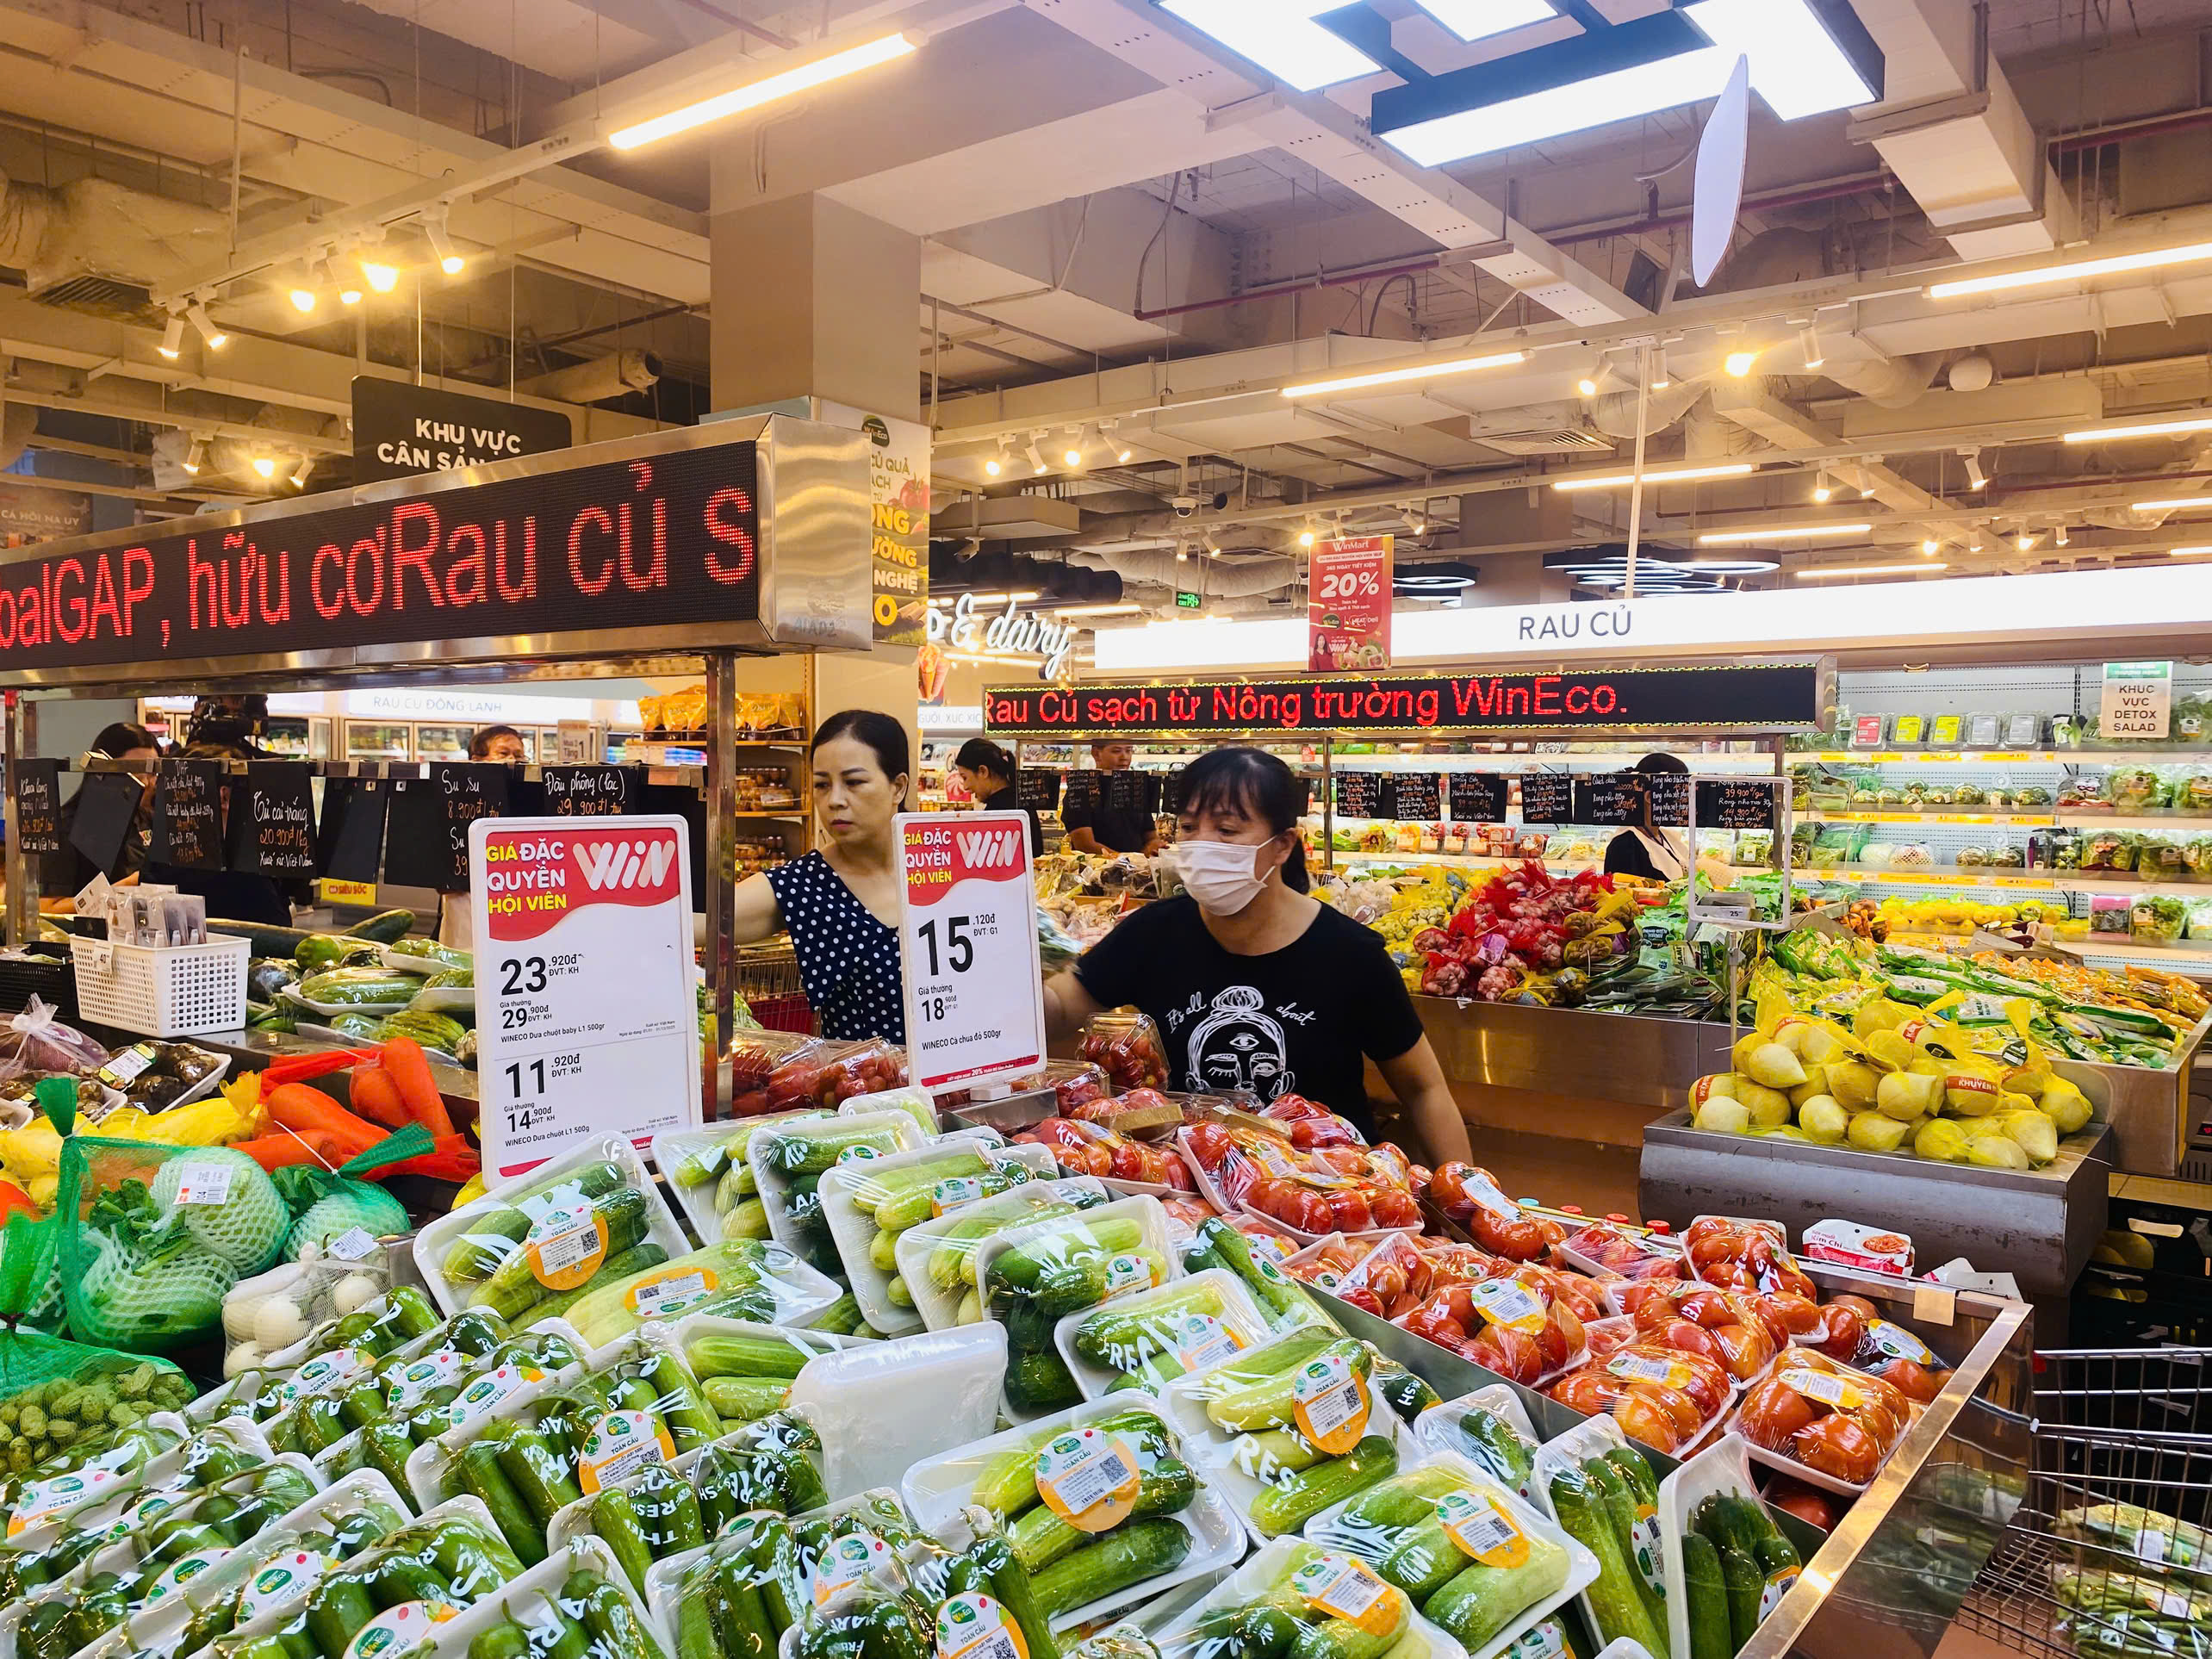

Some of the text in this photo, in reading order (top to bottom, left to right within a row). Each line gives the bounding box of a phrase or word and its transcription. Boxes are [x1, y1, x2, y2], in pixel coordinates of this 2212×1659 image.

[415, 417, 522, 455] KHU VỰC
[376, 442, 431, 469] CÂN
[885, 457, 910, 475] QUẢ
[189, 531, 290, 630] hữu
[569, 458, 668, 596] củ
[704, 485, 754, 586] s
[1333, 541, 1370, 552] WinMart
[873, 569, 918, 593] NGHỆ
[1320, 571, 1380, 598] 20%
[1519, 604, 1632, 641] RAU CỦ
[951, 593, 975, 647] &
[986, 600, 1071, 680] dairy
[374, 696, 401, 709] RAU
[1039, 689, 1078, 723] Củ
[1087, 689, 1157, 728] sạch
[1168, 688, 1202, 722] từ
[1213, 686, 1302, 728] Nông
[1311, 682, 1438, 727] trường
[1451, 676, 1627, 717] WinEco.
[2122, 698, 2149, 708] VỰC
[2113, 723, 2156, 731] SALAD
[579, 741, 584, 758] 1
[442, 769, 459, 794] Su
[570, 771, 595, 798] phộng
[1718, 798, 1737, 807] Rong
[904, 828, 952, 848] GIÁ ĐẶC
[486, 837, 565, 865] GIÁ ĐẶC
[905, 848, 951, 868] QUYỀN
[487, 863, 566, 892] QUYỀN
[907, 868, 952, 887] HỘI VIÊN
[488, 892, 567, 916] HỘI VIÊN
[973, 927, 998, 936] ĐVT: G1
[918, 916, 973, 976] 15
[500, 956, 547, 996] 23
[549, 966, 580, 977] ĐVT: KH
[918, 984, 953, 996] Giá thường
[510, 999, 531, 1008] thường
[922, 997, 945, 1022] 18
[1186, 991, 1207, 1015] all
[502, 1007, 528, 1029] 29
[1276, 1002, 1316, 1026] about
[501, 1033, 528, 1043] WINECO
[543, 1028, 561, 1038] chuột
[562, 1026, 577, 1035] baby
[587, 1022, 606, 1033] 500gr
[922, 1029, 1002, 1050] WINECO Cà chua đỏ 500gr
[505, 1058, 545, 1098] 11
[551, 1066, 582, 1078] ĐVT: KH
[971, 1068, 984, 1077] 20%
[513, 1103, 535, 1112] thường
[506, 1109, 531, 1133] 14
[505, 1135, 531, 1147] WINECO
[532, 1134, 545, 1142] Dưa
[546, 1129, 565, 1140] chuột
[574, 1125, 590, 1134] 500g
[551, 1221, 578, 1237] TOÀN CẦU
[1811, 1234, 1842, 1248] Kim Chi
[1315, 1377, 1340, 1394] TOÀN CẦU
[611, 1436, 639, 1455] TOÀN CẦU
[1267, 1414, 1314, 1456] THE
[1062, 1451, 1091, 1471] TOÀN CẦU
[48, 1498, 71, 1509] TOÀN
[960, 1625, 986, 1645] TOÀN CẦU
